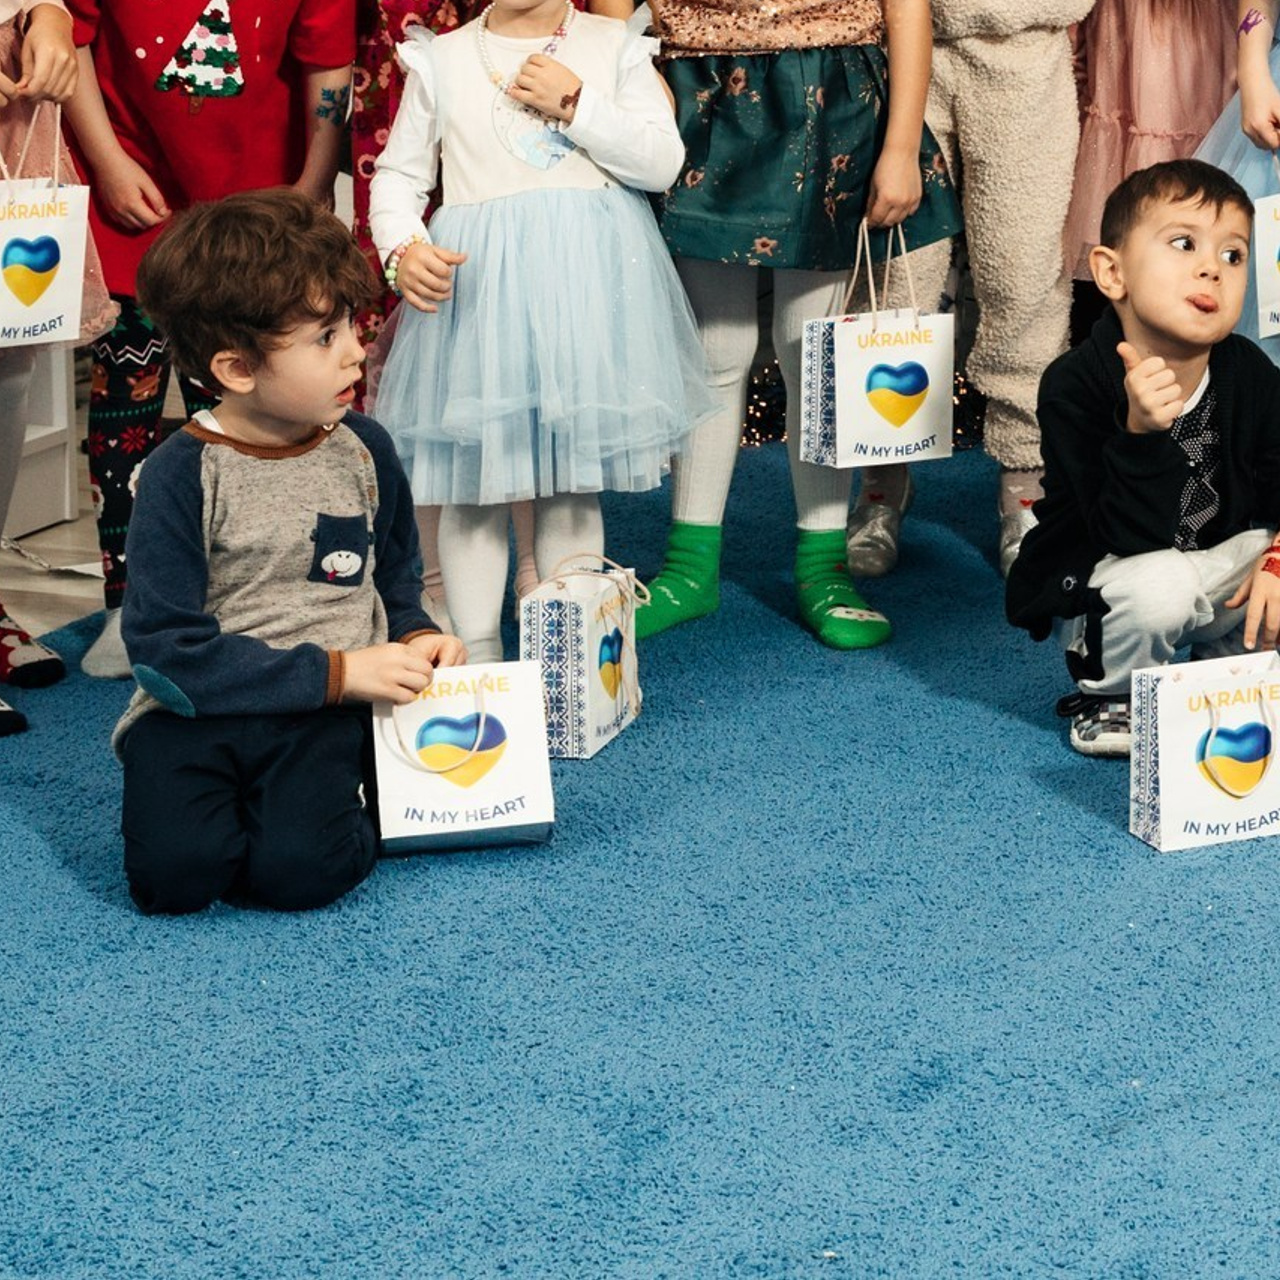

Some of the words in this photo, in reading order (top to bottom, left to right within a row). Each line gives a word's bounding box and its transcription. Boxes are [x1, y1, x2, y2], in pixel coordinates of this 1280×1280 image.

[1, 326, 20, 339] MY
[23, 315, 64, 339] HEART
[1269, 311, 1280, 324] IN
[857, 329, 933, 349] UKRAINE
[854, 442, 868, 456] IN
[871, 446, 892, 458] MY
[895, 434, 937, 456] HEART
[415, 675, 511, 700] KRAINE
[1188, 683, 1280, 712] UKRAINE
[404, 806, 424, 822] IN
[430, 810, 459, 824] MY
[465, 796, 527, 822] HEART
[1183, 820, 1200, 835] IN
[1205, 822, 1231, 836] MY
